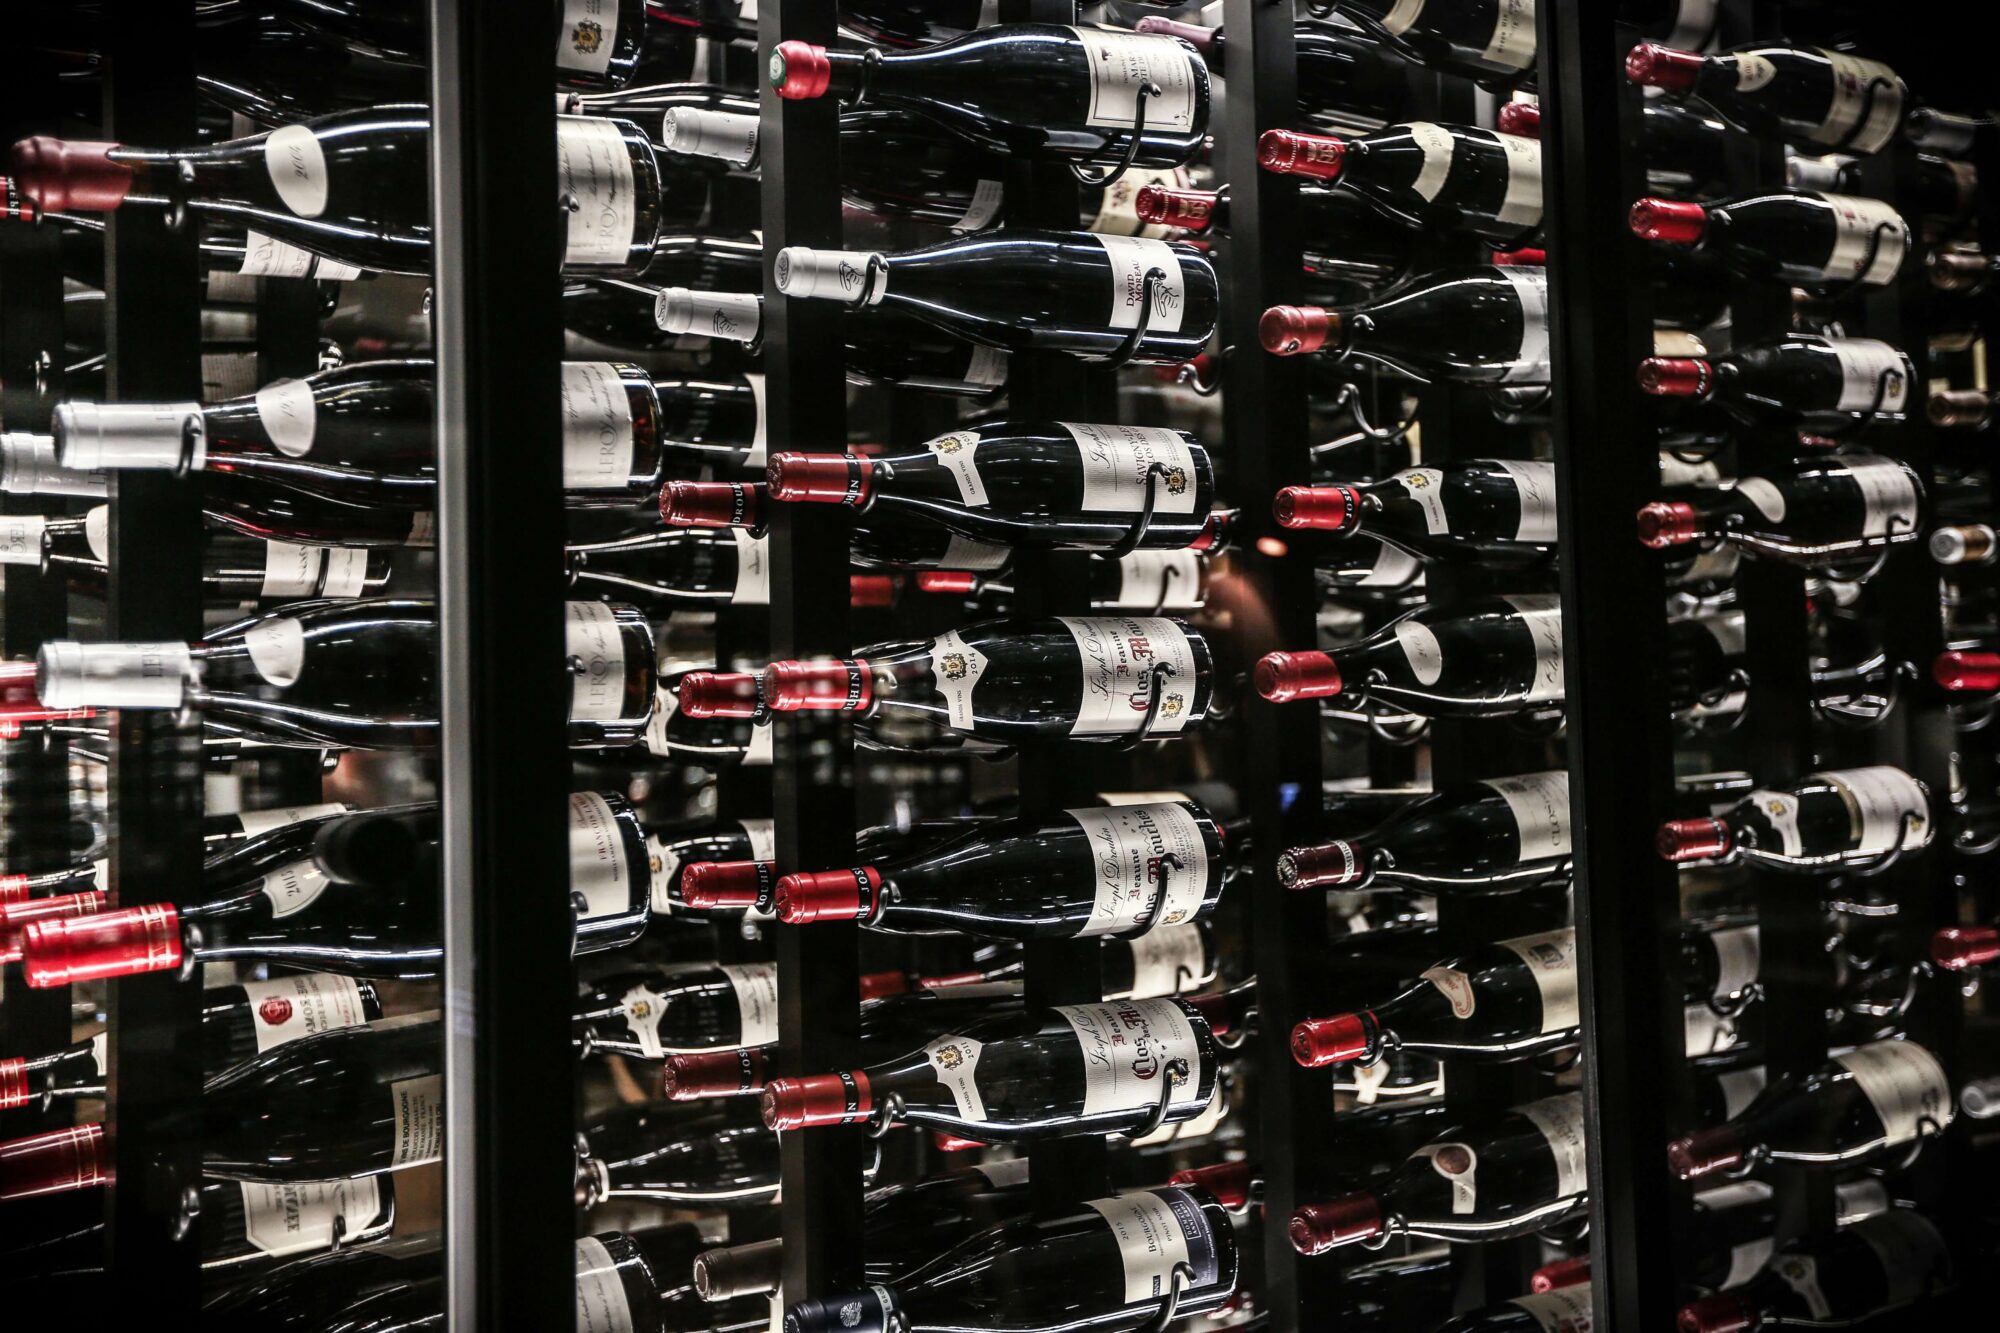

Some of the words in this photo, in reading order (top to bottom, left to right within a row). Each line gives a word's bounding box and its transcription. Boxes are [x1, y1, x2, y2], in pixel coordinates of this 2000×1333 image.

[744, 131, 755, 155] DAVID
[1126, 273, 1135, 307] DAVID
[599, 421, 618, 475] LEROY
[1110, 631, 1130, 678] Beaune
[589, 655, 607, 705] LEROY
[1089, 656, 1112, 701] Joseph
[1127, 670, 1152, 712] Clos
[1096, 826, 1120, 880] Drouhin
[1134, 809, 1166, 884] Mouches
[281, 870, 301, 897] 2015
[1127, 848, 1143, 902] Beaune
[1098, 882, 1124, 920] Joseph
[961, 1041, 974, 1059] 2011
[1087, 1029, 1112, 1071] Joseph
[1141, 1026, 1151, 1038] des
[1131, 1036, 1158, 1080] Clos
[958, 1077, 968, 1091] VINS
[963, 1091, 974, 1112] GRANDS
[400, 1090, 409, 1138] BOURGOGNE
[401, 1138, 409, 1148] DE
[1115, 1220, 1130, 1241] 2015
[1129, 1206, 1157, 1253] BOURGOGNE
[1162, 1222, 1173, 1242] PINOT
[1174, 1204, 1192, 1236] DOMAINE
[1188, 1218, 1198, 1235] ANNE
